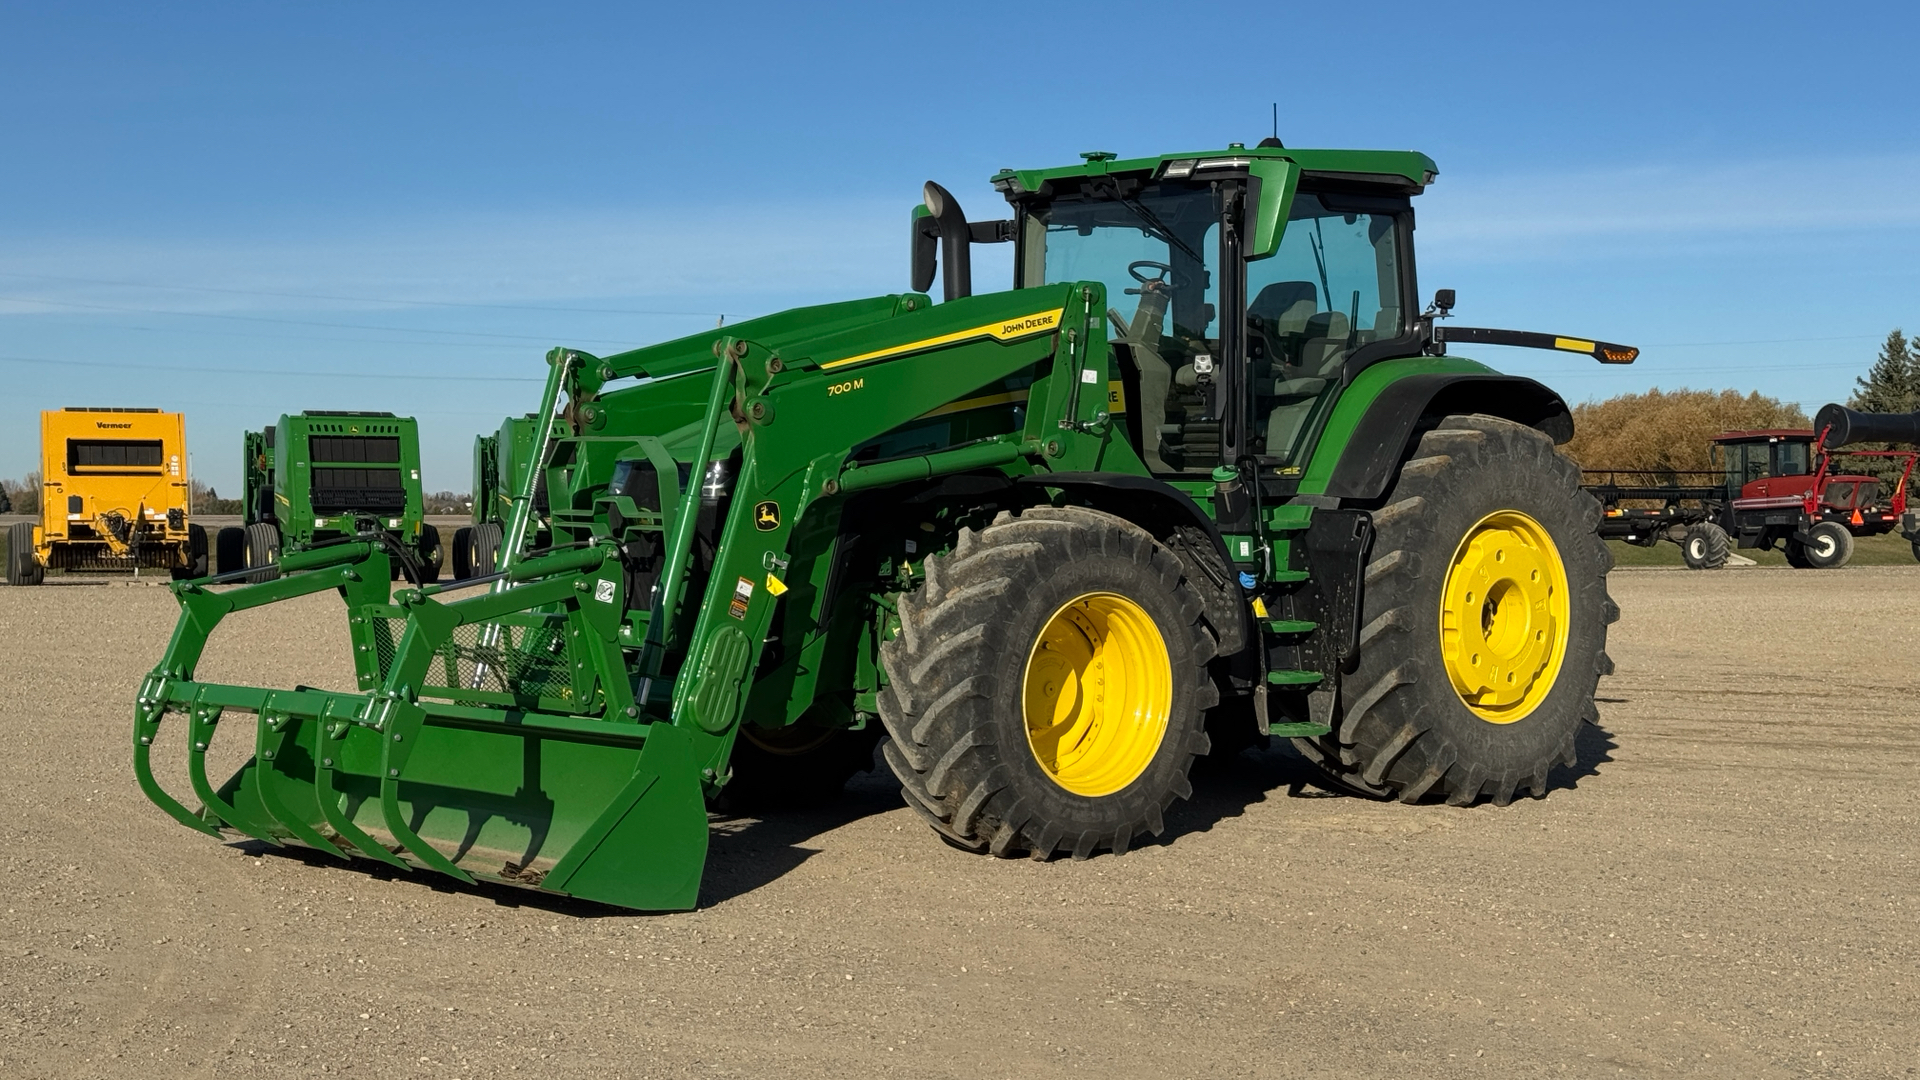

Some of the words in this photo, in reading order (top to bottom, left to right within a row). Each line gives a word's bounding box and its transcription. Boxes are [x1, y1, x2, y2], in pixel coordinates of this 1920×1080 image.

[1002, 323, 1024, 335] JOHN
[1025, 316, 1053, 329] DEERE
[827, 382, 851, 396] 700
[854, 378, 864, 390] M
[96, 421, 133, 429] Vermeer
